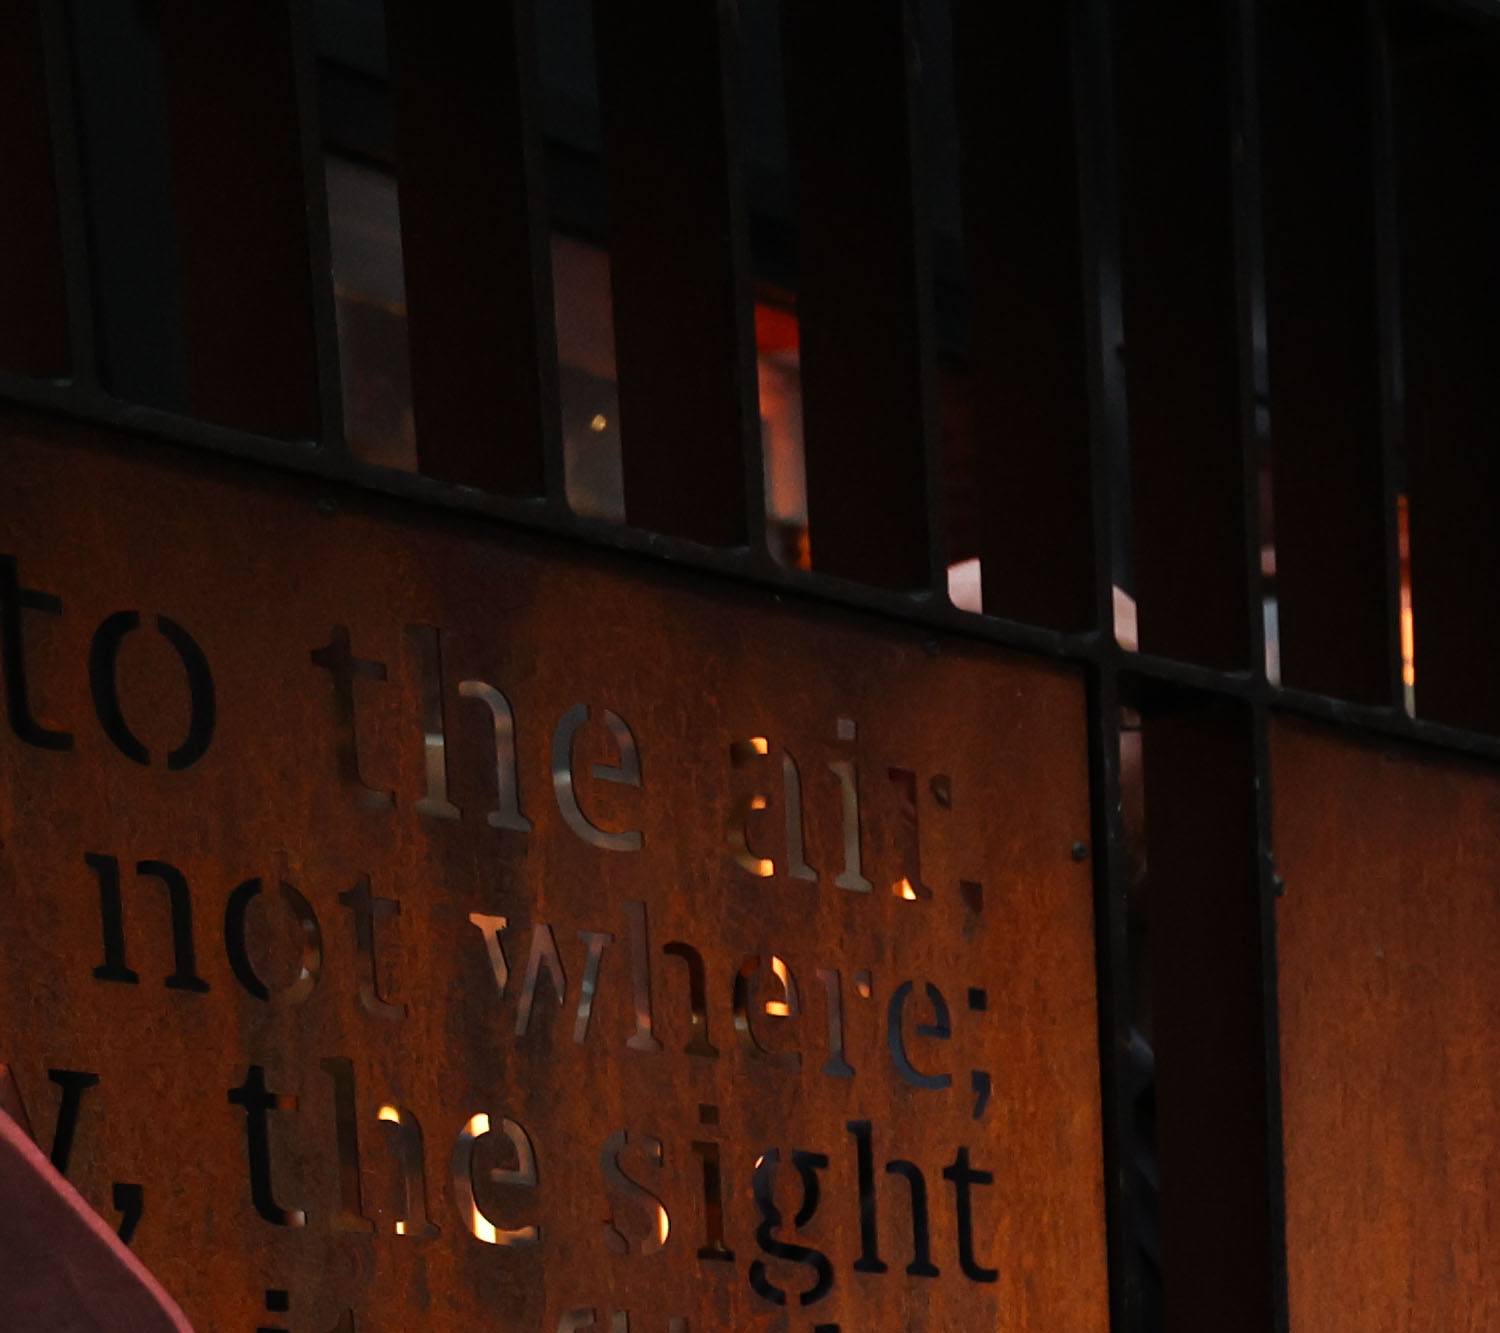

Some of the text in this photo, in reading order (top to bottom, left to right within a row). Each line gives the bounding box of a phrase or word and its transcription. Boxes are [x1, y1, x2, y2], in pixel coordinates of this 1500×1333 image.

[312, 623, 643, 852] the
[84, 852, 992, 1121] not where;
[228, 1056, 540, 1246] the
[603, 1104, 998, 1306] sight
